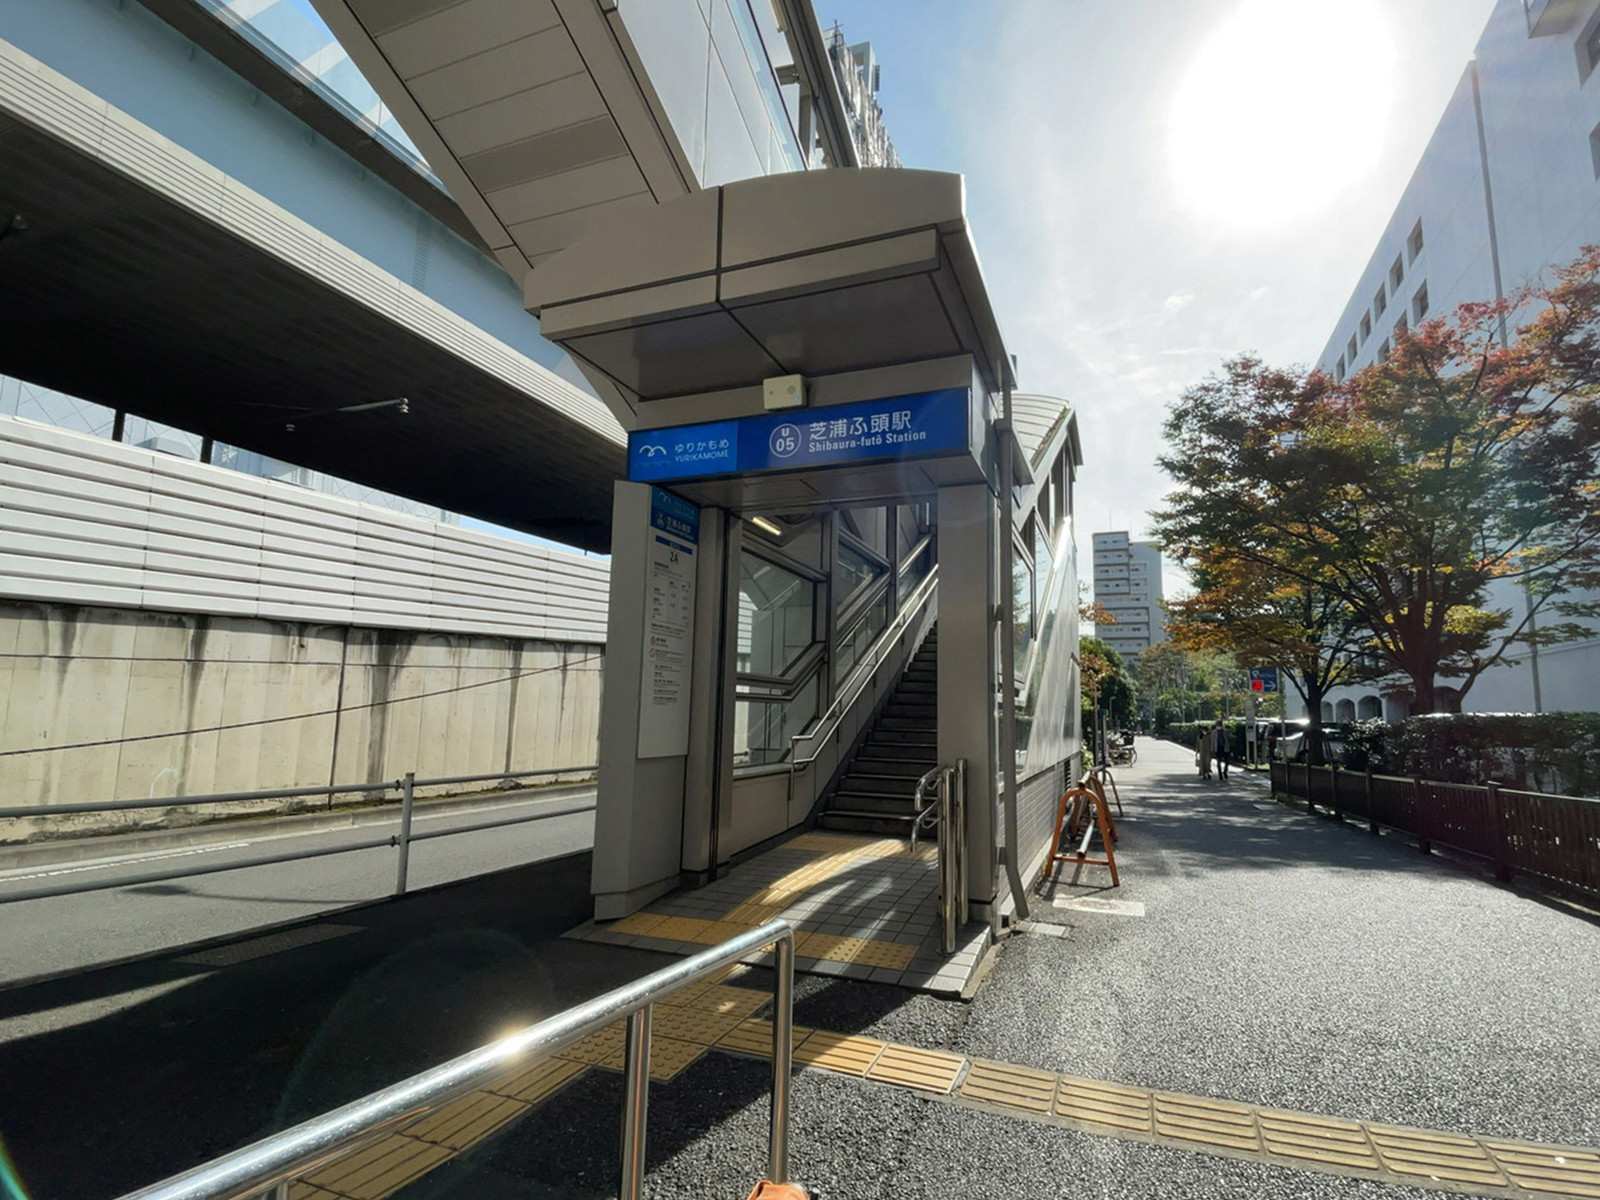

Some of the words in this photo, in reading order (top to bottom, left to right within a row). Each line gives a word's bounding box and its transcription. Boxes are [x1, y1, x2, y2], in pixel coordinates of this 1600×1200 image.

[781, 427, 790, 437] U
[809, 410, 912, 441] 芝浦ふ頭駅
[674, 438, 730, 454] ゆりかもめ
[776, 437, 795, 452] 05
[808, 435, 882, 453] Shibaura-futō
[885, 430, 927, 445] Station
[674, 449, 729, 463] YURIKAMOME
